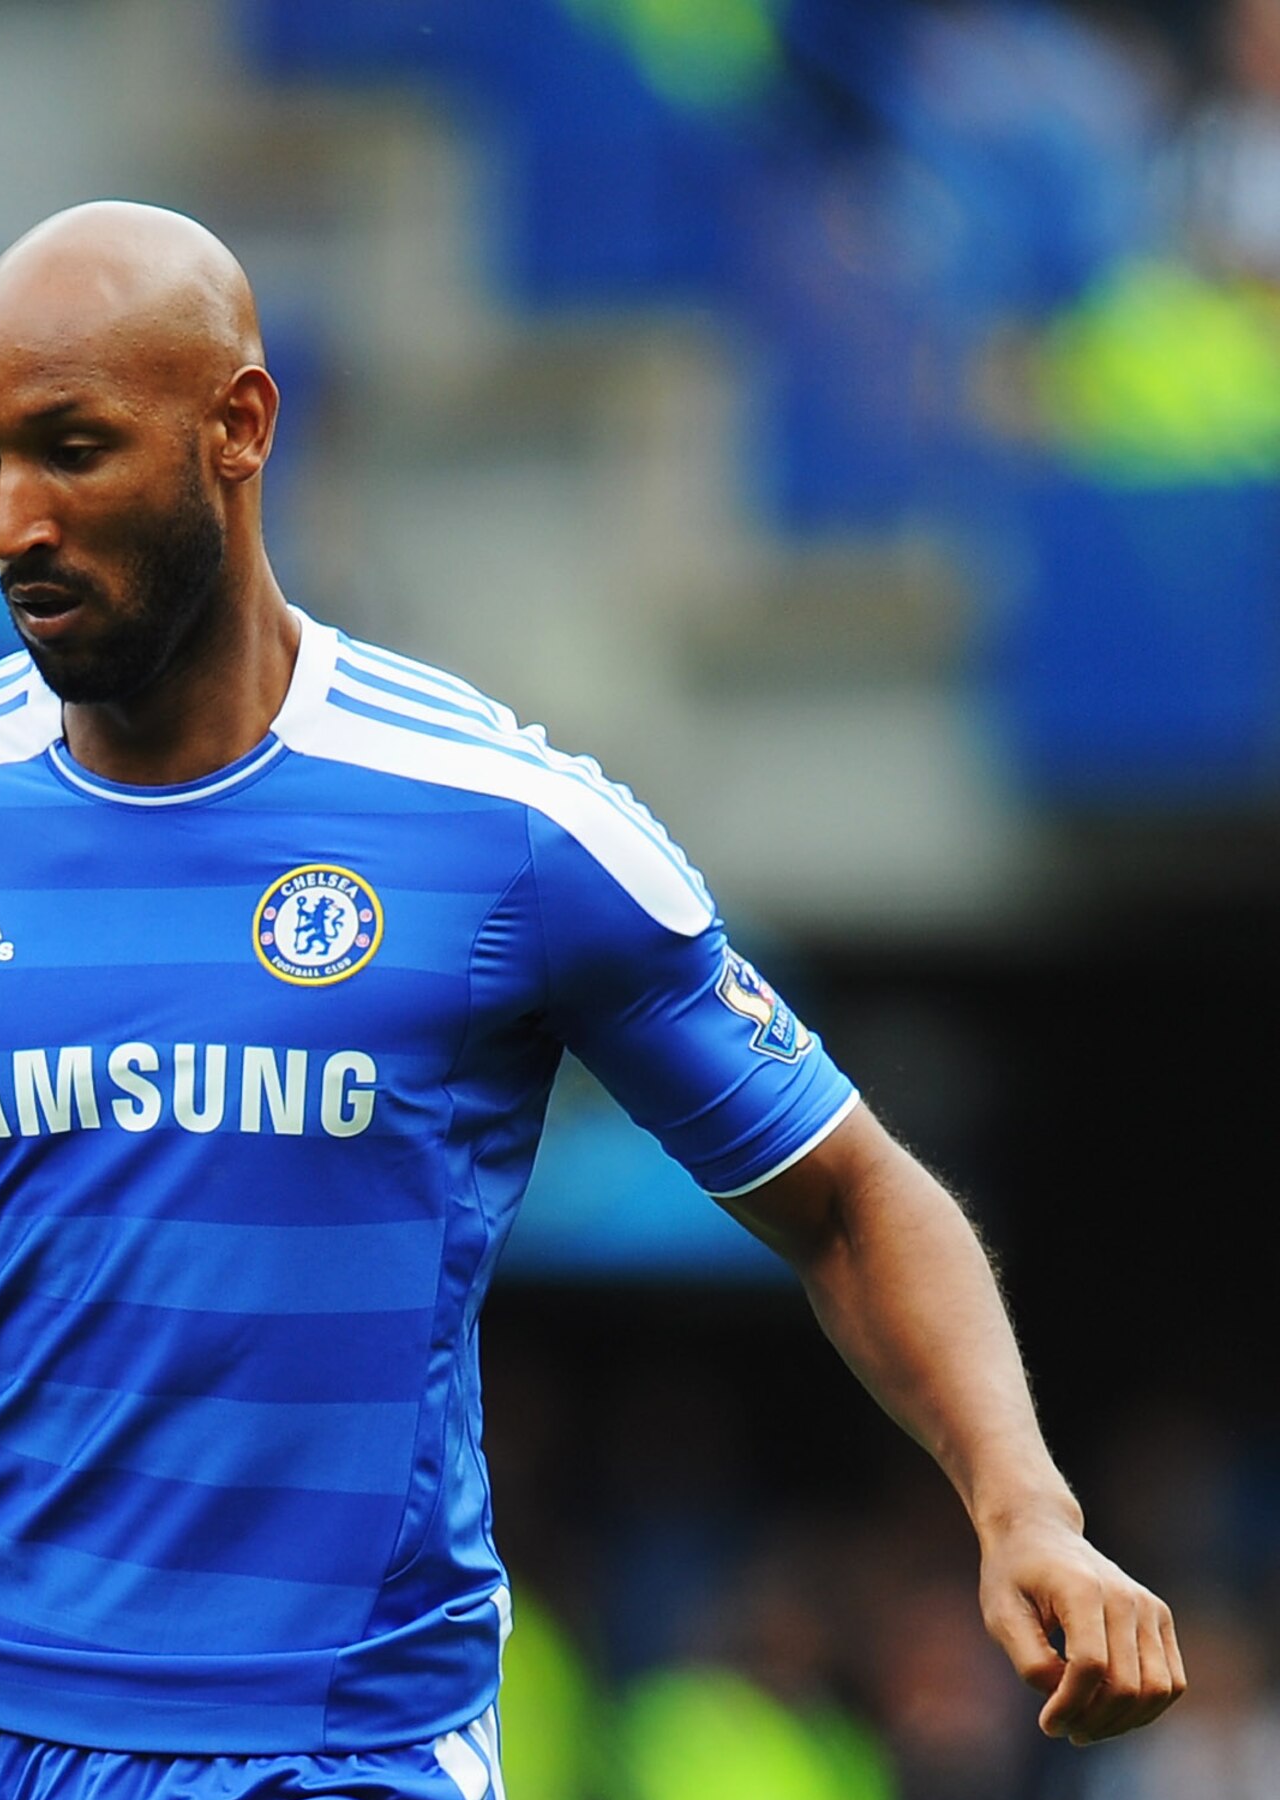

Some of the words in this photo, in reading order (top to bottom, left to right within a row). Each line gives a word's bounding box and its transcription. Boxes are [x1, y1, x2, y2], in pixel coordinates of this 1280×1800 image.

[280, 872, 359, 899] CHELSEA
[271, 955, 320, 978] FOOTBALL
[324, 956, 353, 976] CLUB
